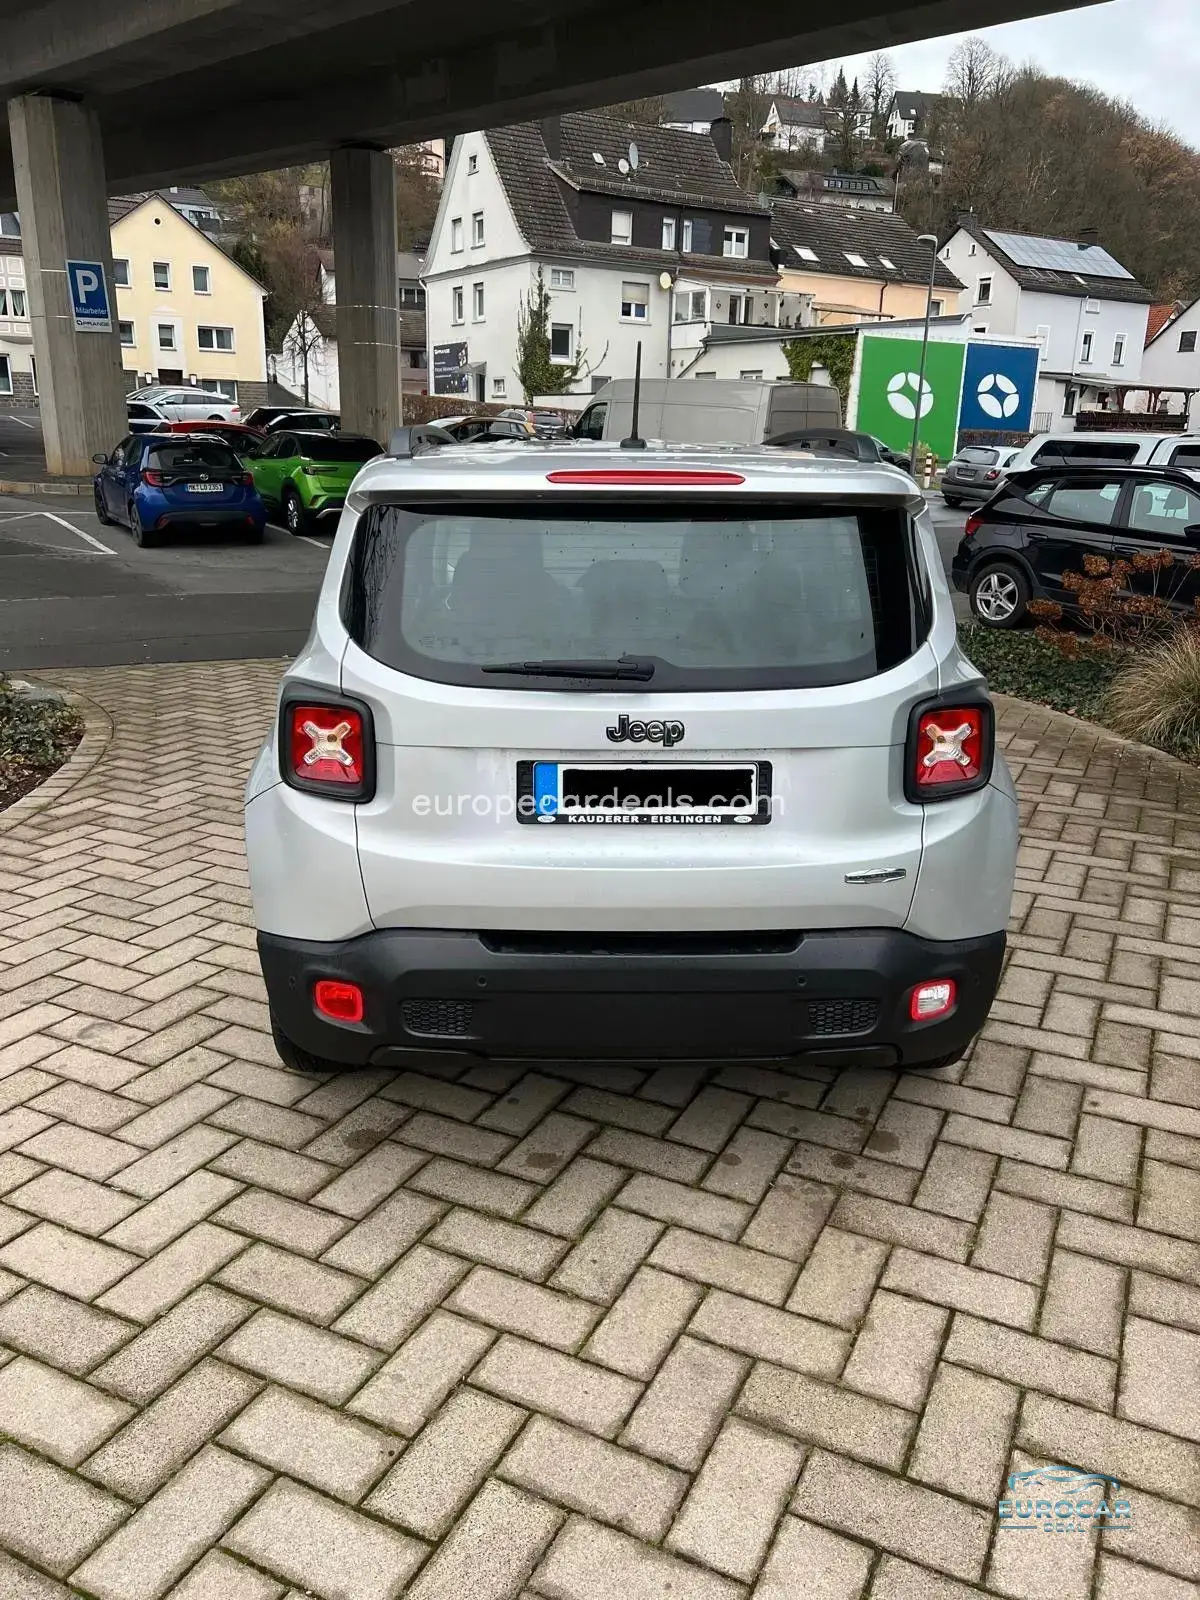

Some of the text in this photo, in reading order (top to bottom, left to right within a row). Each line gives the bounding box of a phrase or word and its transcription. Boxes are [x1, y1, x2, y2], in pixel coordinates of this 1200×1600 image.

[76, 269, 99, 304] P
[75, 306, 108, 316] Mitarbeiter
[606, 714, 685, 747] Jeep
[568, 815, 722, 823] KAUDERER EISLINGEN
